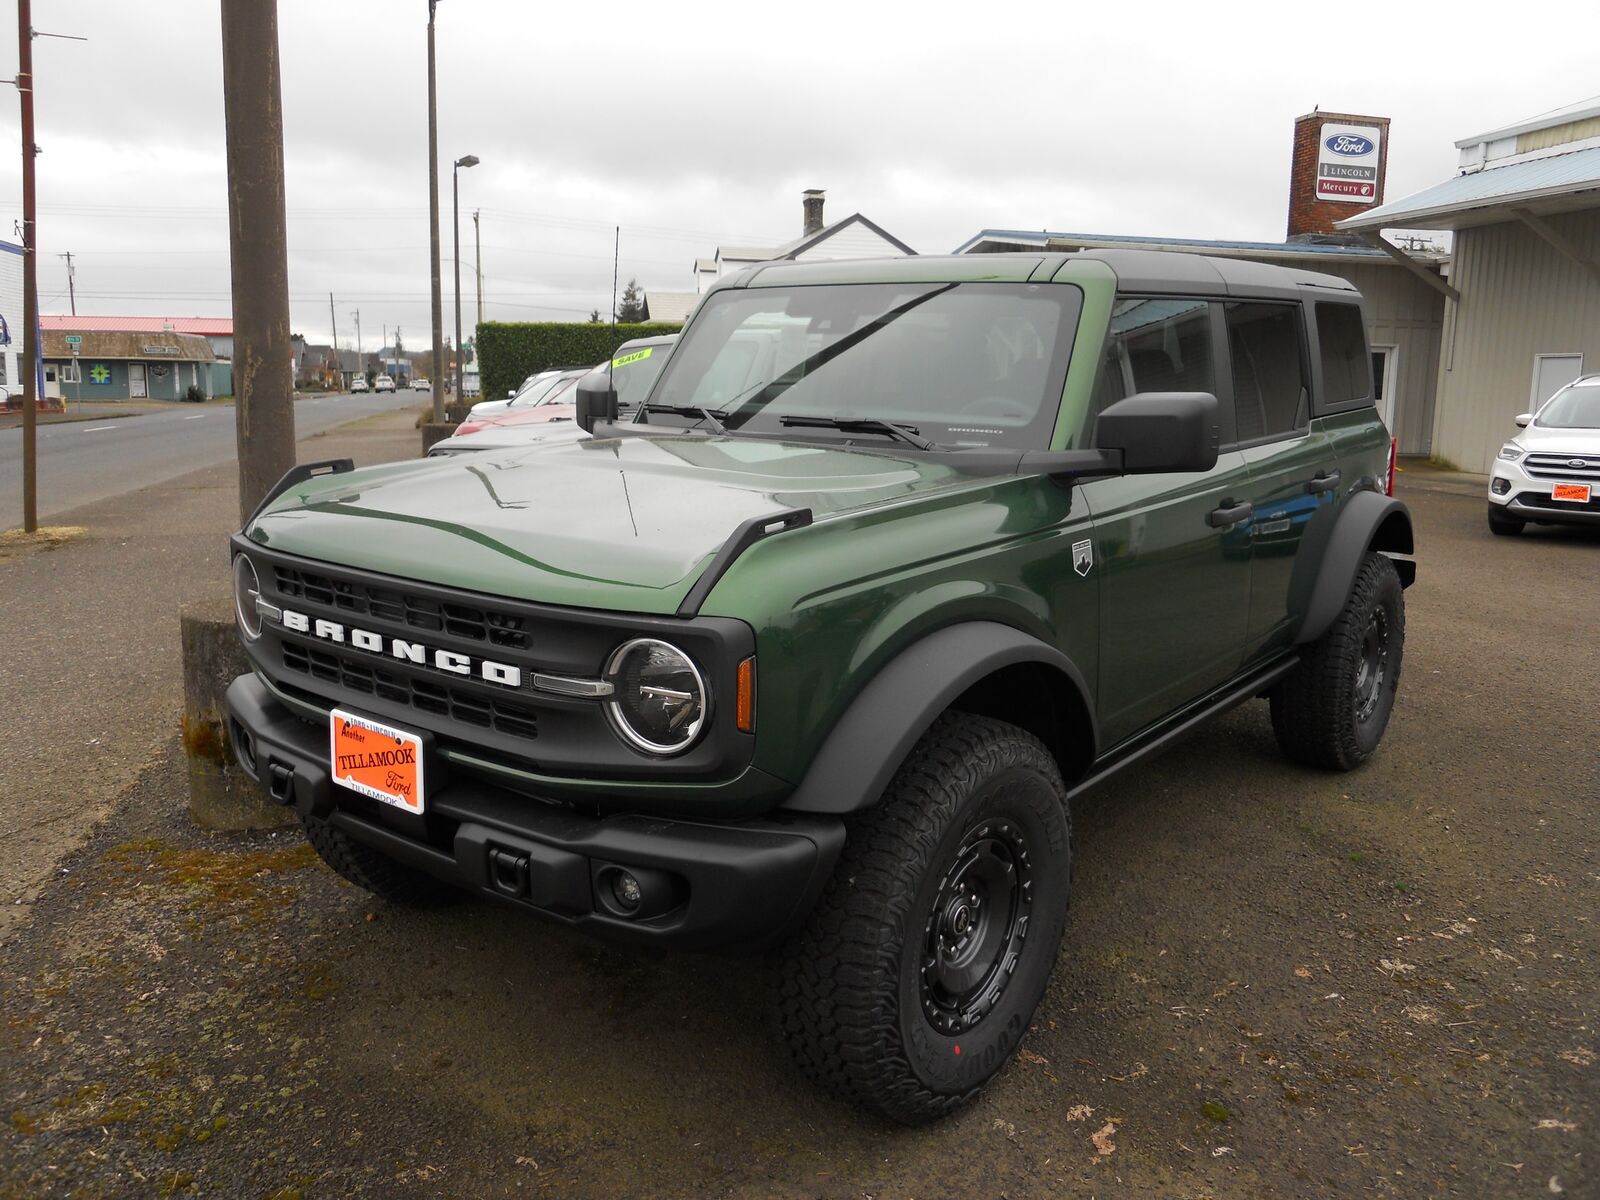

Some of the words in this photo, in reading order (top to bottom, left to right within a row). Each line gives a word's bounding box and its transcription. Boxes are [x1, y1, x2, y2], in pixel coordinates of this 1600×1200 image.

[1334, 136, 1366, 153] Ford
[1331, 165, 1371, 178] LINCOLN
[1322, 183, 1358, 194] Mercury
[617, 351, 645, 365] SAVE
[283, 609, 521, 687] BRONCO
[341, 725, 365, 743] Another
[338, 748, 415, 770] TILLAMOOK
[385, 770, 412, 796] Ford
[350, 783, 398, 806] TILLAMOOK
